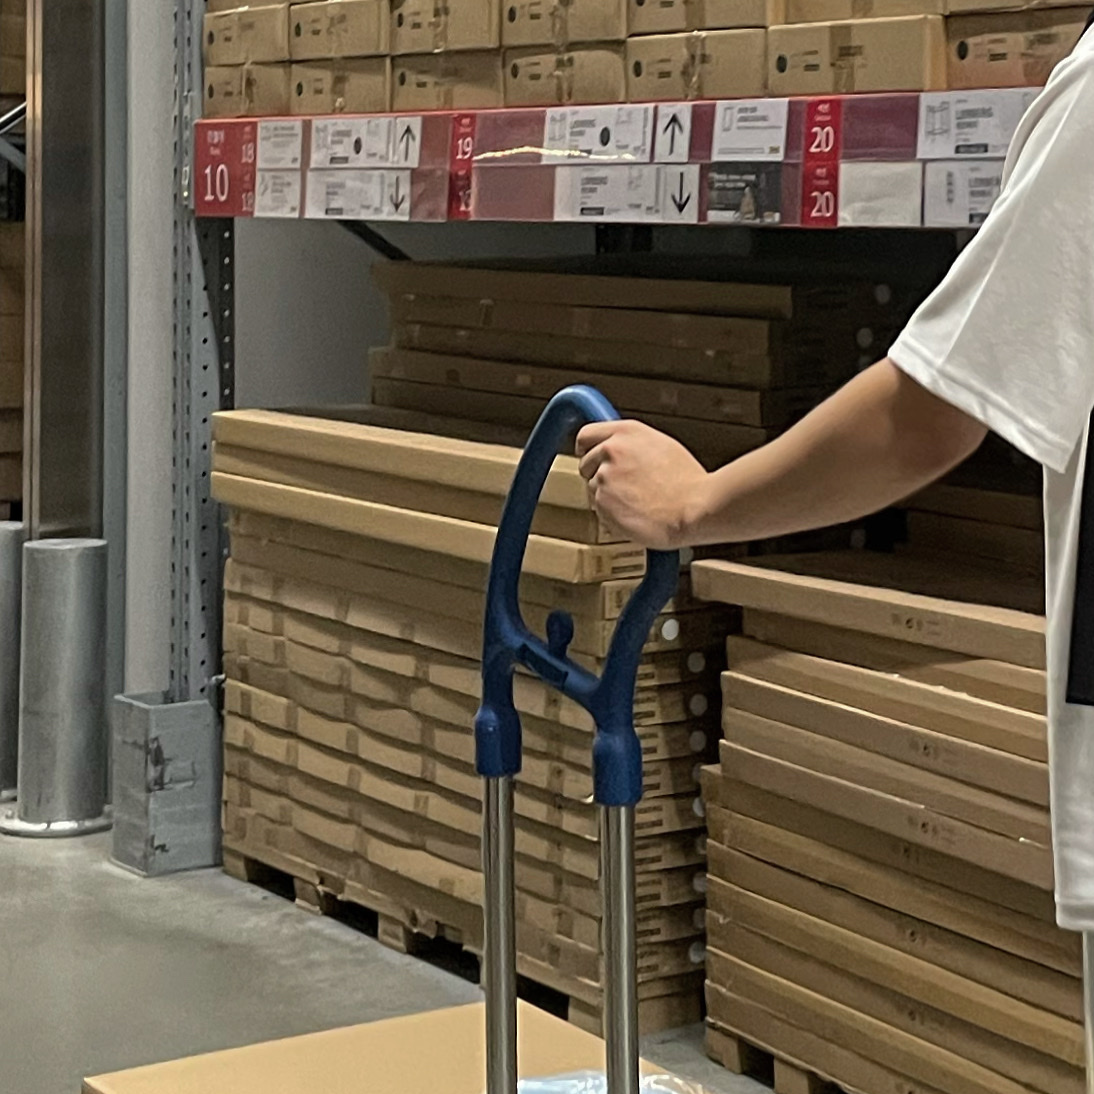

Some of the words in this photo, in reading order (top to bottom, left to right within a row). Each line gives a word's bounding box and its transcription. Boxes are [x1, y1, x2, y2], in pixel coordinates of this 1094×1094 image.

[455, 136, 473, 160] 19
[808, 125, 835, 153] 20
[204, 163, 229, 203] 10
[810, 190, 835, 218] 20
